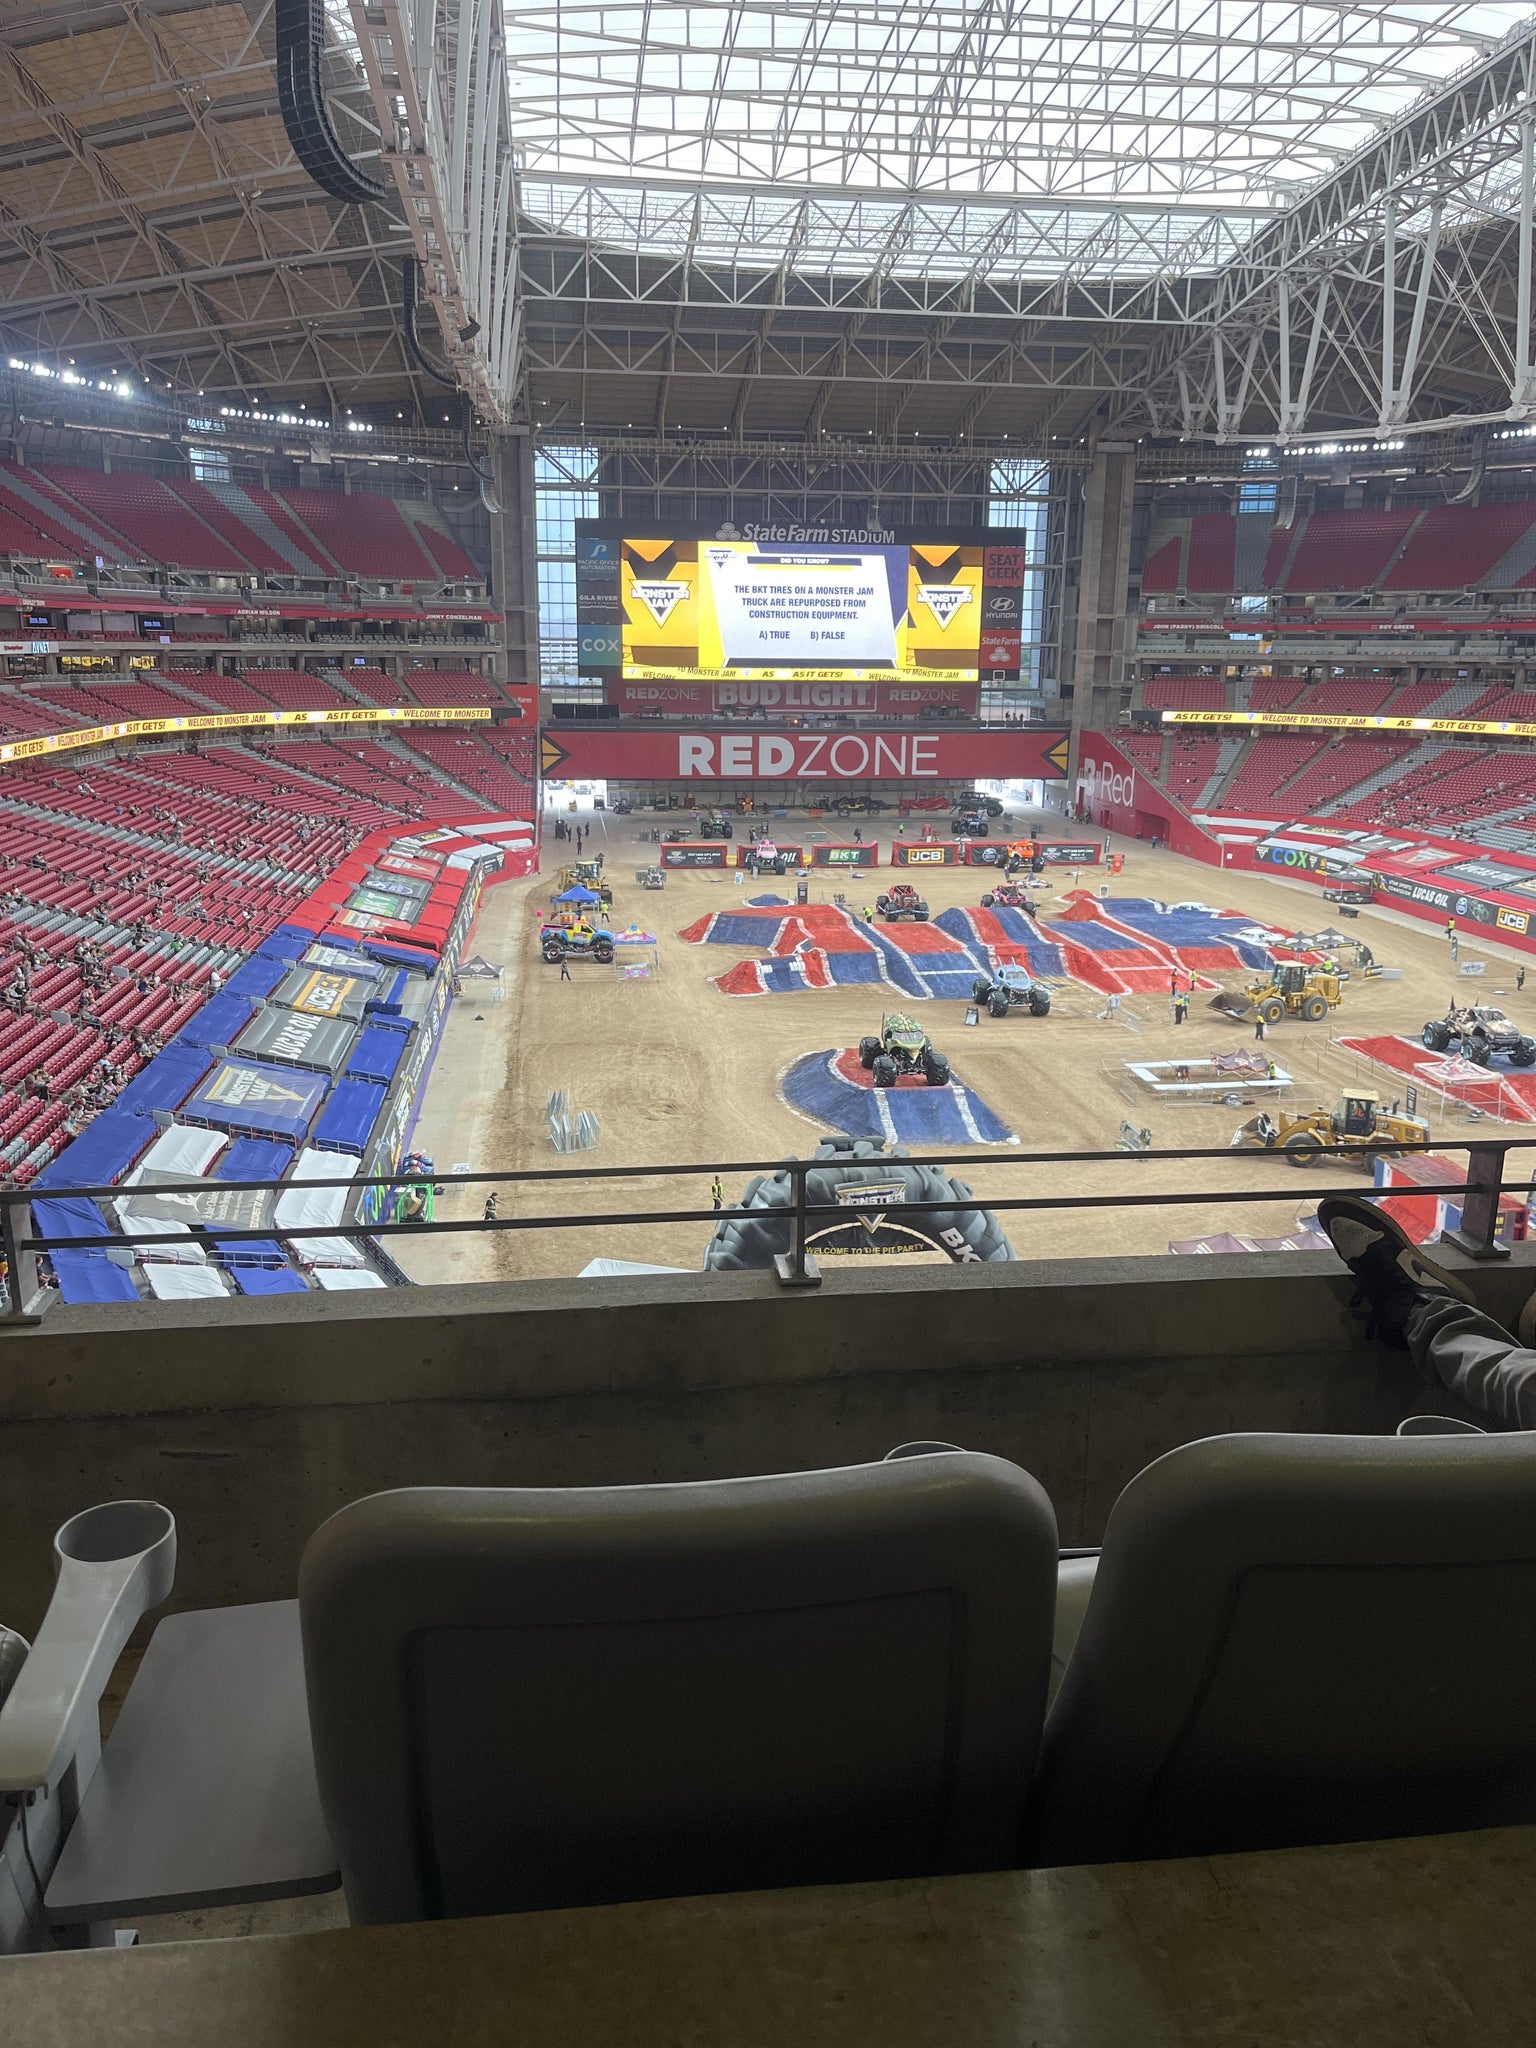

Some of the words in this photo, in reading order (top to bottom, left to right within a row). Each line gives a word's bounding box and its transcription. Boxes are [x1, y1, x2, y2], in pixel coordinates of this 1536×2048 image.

[832, 530, 895, 544] STADIUM
[989, 554, 1020, 566] SEAT
[987, 568, 1020, 579] GEEK
[632, 588, 690, 599] MONSTER
[734, 585, 749, 594] THE
[752, 586, 767, 594] BKT
[770, 586, 792, 594] TIRES
[795, 586, 806, 594] ON
[816, 586, 854, 595] MONSTER
[856, 587, 874, 595] JAM
[742, 598, 768, 606] TRUCK
[770, 598, 786, 606] ARE
[789, 598, 841, 607] REPURPOSED
[844, 599, 866, 608] FROM
[918, 593, 972, 603] MONSTER
[749, 610, 809, 619] CONSTRUCTION
[812, 611, 858, 620] EQUIPMENT.
[759, 631, 768, 640] A)
[770, 631, 790, 639] TRUE
[810, 632, 819, 640] B)
[822, 632, 845, 640] FALSE
[582, 638, 619, 652] COX
[687, 667, 719, 676] MONSTER
[912, 669, 943, 678] MONSTER
[626, 687, 700, 700] REDZONE
[719, 683, 780, 705] BUD
[786, 683, 871, 706] LIGHT
[890, 689, 960, 701] REDZONE
[404, 710, 442, 718] WELCOME
[443, 709, 453, 718] TO
[454, 709, 490, 718] MONSTER
[1262, 714, 1297, 723] WELCOME
[1311, 716, 1347, 725] MONSTER
[142, 722, 166, 731] GETS!
[188, 717, 216, 727] WELCOME
[216, 717, 224, 726] TO
[224, 715, 249, 725] MONSTER
[250, 714, 266, 723] JAM
[1515, 725, 1536, 733] WELC
[14, 746, 20, 756] AS
[22, 744, 28, 754] IT
[28, 741, 44, 753] GETS!
[679, 736, 940, 776] REDZONE
[1101, 761, 1135, 807] Red
[829, 851, 860, 859] BKT
[911, 852, 941, 862] JCB
[1272, 848, 1308, 868] COX
[1412, 886, 1435, 904] LUCAS
[1435, 893, 1449, 907] OIL
[1500, 913, 1525, 929] JCB
[306, 987, 338, 1010] JCB
[288, 1012, 323, 1029] OIL
[268, 1026, 312, 1060] LUCAS
[223, 1070, 258, 1104] MONSTER
[806, 1246, 848, 1255] WELCOME
[897, 1244, 925, 1253] PARTY
[939, 1227, 982, 1262] BK
